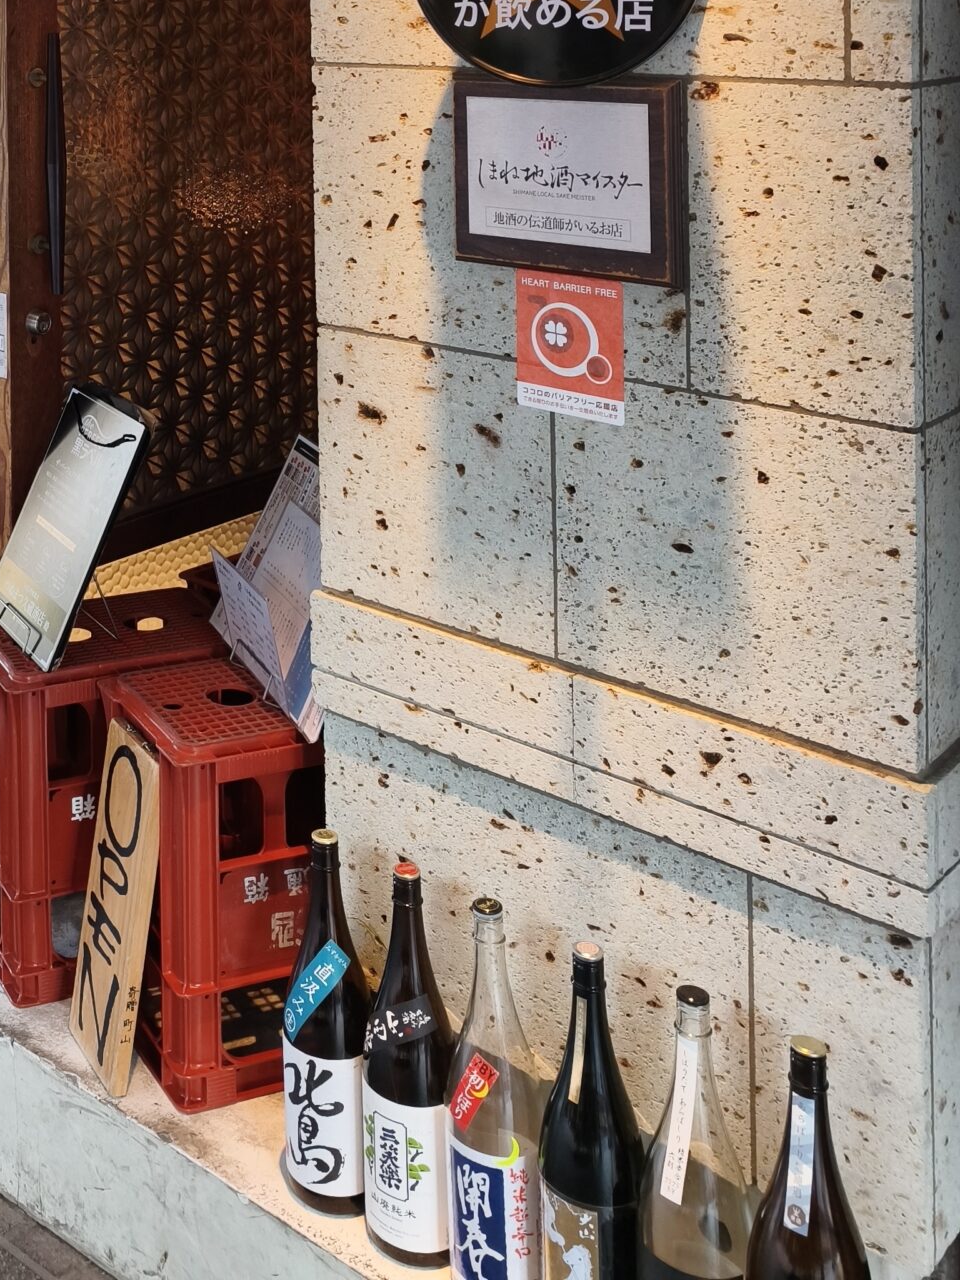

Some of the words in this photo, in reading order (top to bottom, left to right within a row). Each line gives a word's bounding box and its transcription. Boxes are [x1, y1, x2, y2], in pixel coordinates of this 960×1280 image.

[478, 158, 643, 200] しまね地酒マイスター
[512, 188, 537, 197] SHIMANE
[493, 211, 623, 238] 地酒の伝道師がいるお店
[521, 277, 550, 288] HEART
[553, 281, 592, 295] BARRIER
[595, 287, 618, 299] FREE
[284, 1059, 345, 1184] 北島
